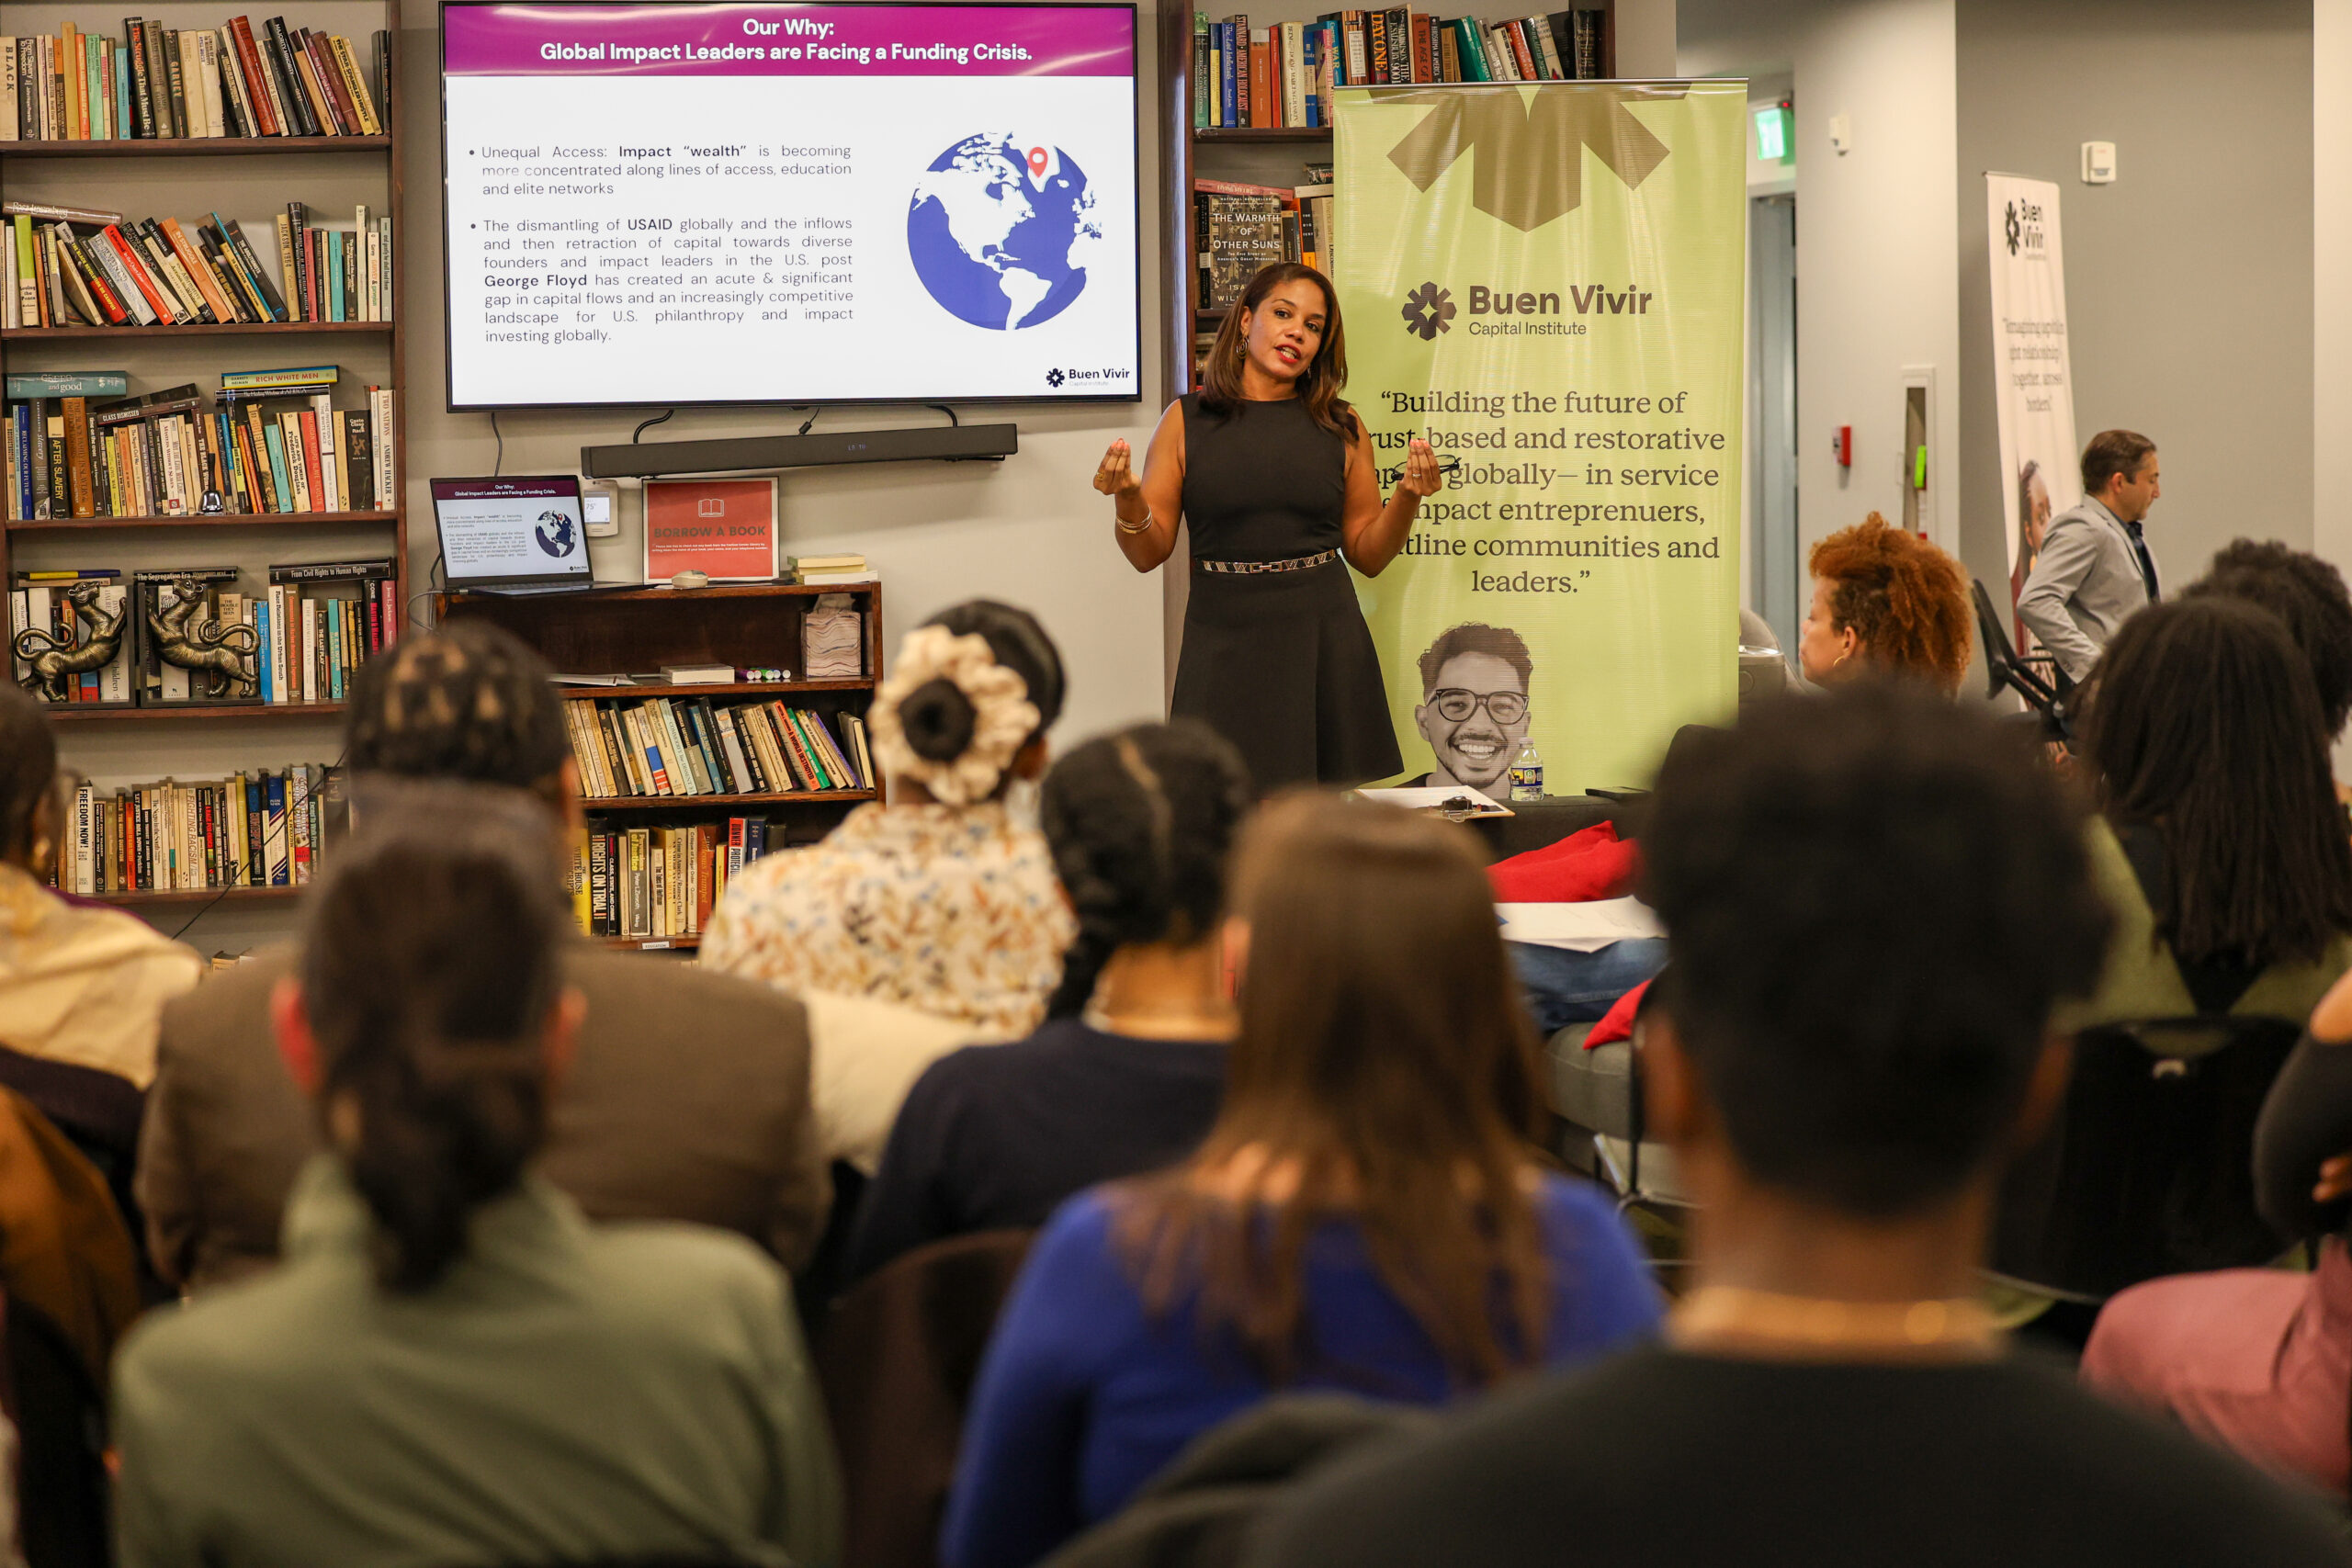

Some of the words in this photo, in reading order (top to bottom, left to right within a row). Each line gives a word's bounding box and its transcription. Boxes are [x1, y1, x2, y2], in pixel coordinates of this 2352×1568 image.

[132, 27, 141, 41] The
[743, 18, 780, 36] Our
[785, 18, 835, 40] Why:
[1372, 14, 1385, 41] DAY
[26, 39, 34, 55] From
[540, 43, 605, 60] Global
[610, 43, 681, 64] Impact
[685, 44, 765, 60] Leaders
[770, 48, 802, 61] are
[807, 43, 870, 64] Facing
[875, 48, 888, 60] a
[891, 43, 969, 64] Funding
[974, 43, 1033, 60] Crisis.
[1374, 41, 1388, 72] ONE
[6, 46, 15, 91] BLACK
[27, 56, 35, 79] Slavery
[134, 42, 144, 76] Struggle
[138, 77, 148, 95] That
[170, 61, 182, 97] GARVEY
[141, 96, 150, 118] Must
[143, 118, 152, 130] Be
[481, 145, 540, 162] Unequal
[552, 146, 607, 158] Access:
[619, 145, 673, 161] Impact
[684, 144, 747, 157] “wealth”
[759, 144, 770, 157] is
[781, 144, 851, 160] becoming
[482, 167, 519, 176] more
[524, 164, 622, 176] concentrated
[627, 164, 664, 179] along
[669, 163, 701, 175] lines
[706, 163, 719, 175] of
[724, 165, 776, 176] access,
[781, 163, 852, 175] education
[482, 183, 509, 195] and
[514, 182, 545, 195] elite
[548, 182, 614, 195] networks
[1213, 213, 1233, 222] THE
[1235, 213, 1280, 222] WARMTH
[2021, 198, 2043, 222] Buen
[483, 220, 510, 231] The
[516, 219, 599, 234] dismantling
[606, 219, 620, 231] of
[628, 218, 673, 231] USAID
[680, 218, 733, 233] globally
[741, 218, 767, 230] and
[774, 217, 797, 230] the
[804, 217, 853, 230] inflows
[1240, 227, 1253, 236] OF
[280, 223, 289, 250] JACKSON,
[483, 238, 511, 251] and
[522, 237, 555, 250] then
[566, 237, 637, 250] retraction
[648, 236, 662, 249] of
[673, 236, 721, 252] capital
[733, 235, 790, 248] towards
[801, 235, 853, 248] diverse
[1213, 240, 1249, 250] OTHER
[1251, 240, 1280, 249] SUNS
[2022, 225, 2044, 249] Vivir
[283, 253, 291, 267] 1964
[483, 256, 548, 269] founders
[560, 255, 587, 268] and
[599, 255, 649, 270] impact
[662, 254, 713, 267] leaders
[726, 254, 738, 266] in
[750, 254, 773, 266] the
[785, 254, 809, 266] U.S.
[821, 254, 853, 268] post
[484, 275, 539, 290] George
[547, 274, 587, 289] Floyd
[595, 274, 619, 286] has
[627, 273, 683, 286] created
[691, 276, 707, 285] an
[715, 274, 755, 285] acute
[763, 272, 774, 285] &
[782, 271, 853, 287] significant
[484, 296, 512, 309] gap
[516, 293, 528, 305] in
[533, 292, 582, 308] capital
[586, 292, 623, 304] flows
[628, 291, 654, 304] and
[659, 294, 676, 303] an
[681, 290, 764, 306] increasingly
[769, 289, 854, 305] competitive
[1469, 285, 1561, 315] Buen
[1570, 283, 1653, 315] Vivir
[485, 311, 559, 326] landscape
[576, 310, 595, 323] for
[613, 310, 638, 322] U.S.
[655, 309, 744, 324] philanthropy
[762, 309, 787, 321] and
[805, 308, 853, 322] impact
[485, 329, 549, 345] investing
[554, 329, 611, 344] globally.
[1469, 321, 1522, 339] Capital
[1525, 321, 1588, 335] Institute
[276, 373, 300, 381] WHITE
[1069, 369, 1100, 379] Buen
[1102, 368, 1131, 378] Vivir
[1381, 390, 1506, 418] “Building
[1511, 390, 1557, 413] the
[1563, 390, 1651, 413] future
[1657, 390, 1689, 413] of
[382, 411, 390, 436] NATIONS
[1514, 427, 1567, 449] and
[1574, 427, 1725, 450] restorative
[51, 439, 62, 465] AFTER
[53, 467, 64, 501] SLAVERY
[384, 469, 392, 494] HACKER
[1586, 463, 1613, 486] in
[1620, 463, 1719, 486] service
[1498, 500, 1705, 526] entreprenuers,
[653, 525, 713, 538] BORROW
[716, 525, 725, 537] A
[729, 525, 766, 536] BOOK
[1473, 534, 1660, 558] communities
[1667, 536, 1720, 558] and
[291, 570, 302, 578] From
[303, 569, 314, 577] Civil
[314, 569, 329, 578] Rights
[335, 567, 352, 575] Human
[352, 566, 367, 575] Rights
[1472, 570, 1590, 593] leaders.”
[79, 788, 89, 827] FREEDOM
[79, 827, 89, 848] NOW!
[592, 841, 605, 873] RIGHTS
[593, 874, 606, 886] ON
[593, 887, 607, 912] TRIAL
